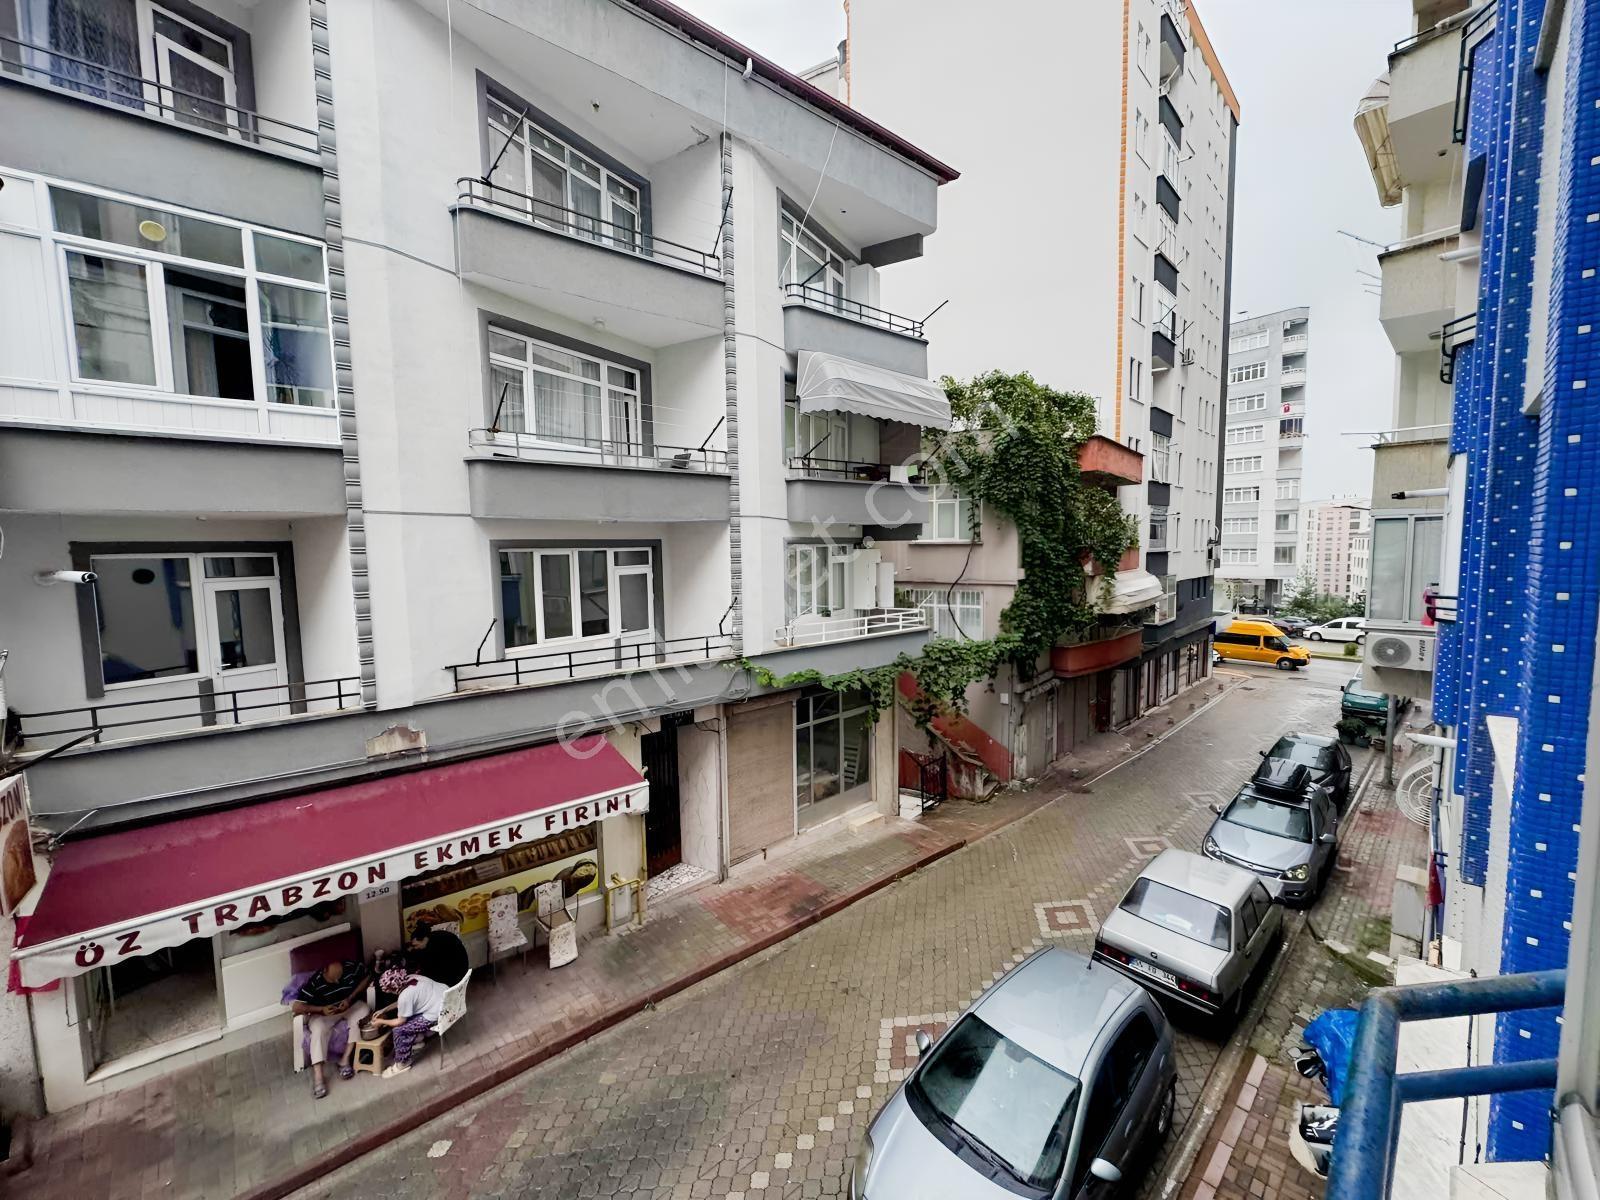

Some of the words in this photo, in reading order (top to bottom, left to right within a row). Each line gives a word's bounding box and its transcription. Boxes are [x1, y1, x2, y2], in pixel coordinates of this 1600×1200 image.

[75, 931, 142, 967] ÖZ
[181, 862, 386, 934] TRABZON
[414, 824, 523, 870] EKMEK
[545, 794, 631, 831] FIRINI
